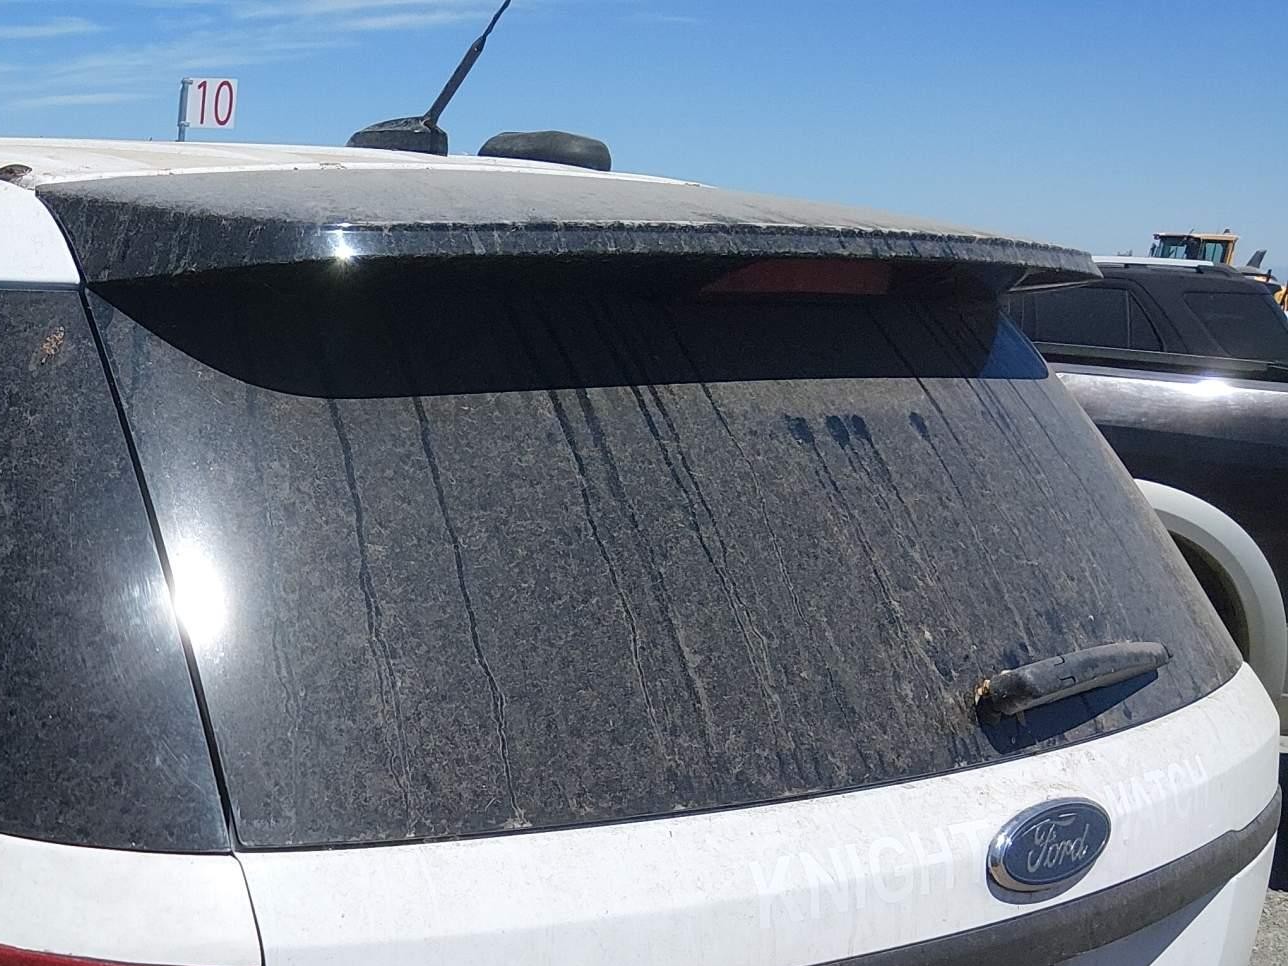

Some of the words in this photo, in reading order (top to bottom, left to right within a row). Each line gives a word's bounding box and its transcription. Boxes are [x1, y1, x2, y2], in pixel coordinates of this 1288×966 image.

[198, 80, 233, 126] 10
[749, 818, 991, 929] KNIGHT
[1024, 811, 1090, 874] Ford
